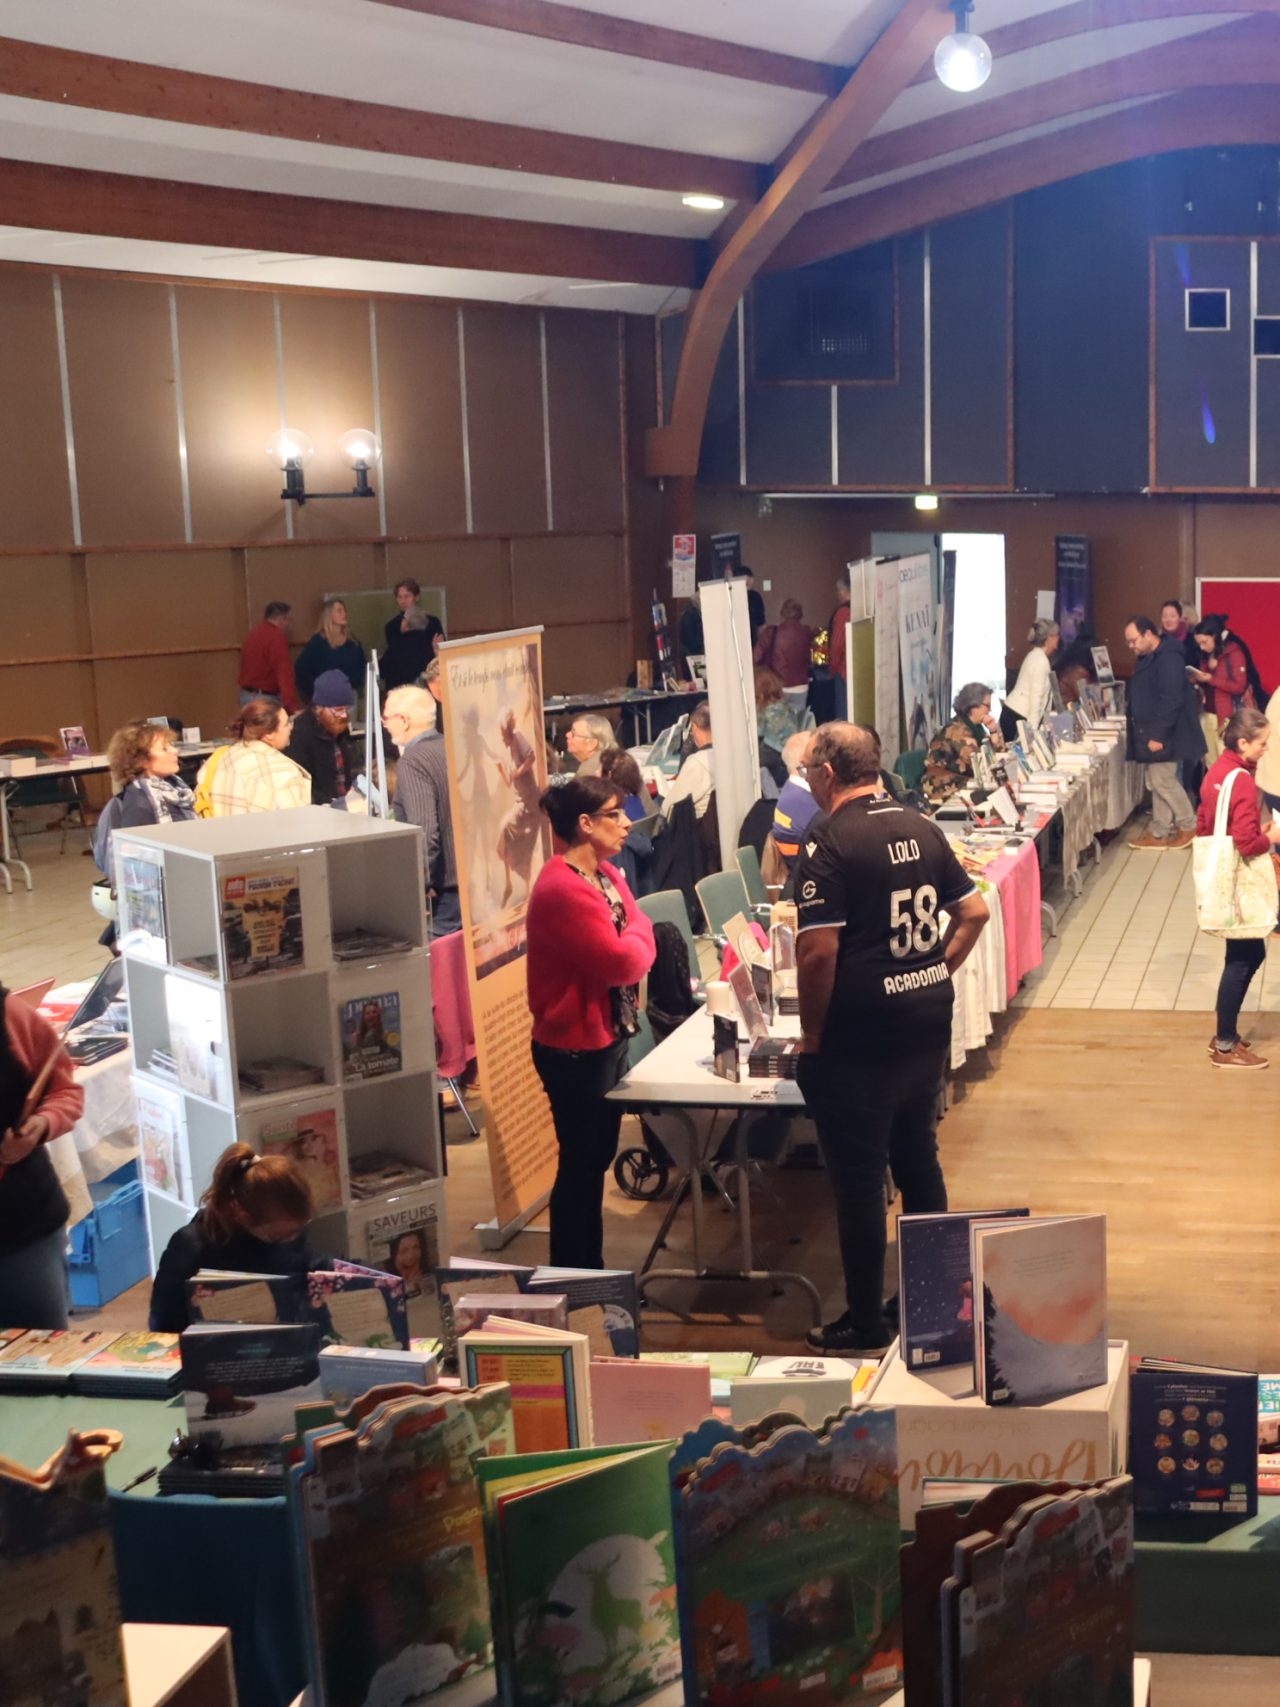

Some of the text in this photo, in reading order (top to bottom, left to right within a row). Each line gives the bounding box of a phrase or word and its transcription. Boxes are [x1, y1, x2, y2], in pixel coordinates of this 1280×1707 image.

[888, 839, 920, 865] LOLO
[889, 884, 938, 959] 58
[883, 962, 949, 995] ACADOMIA
[374, 1203, 437, 1231] SAVEURS
